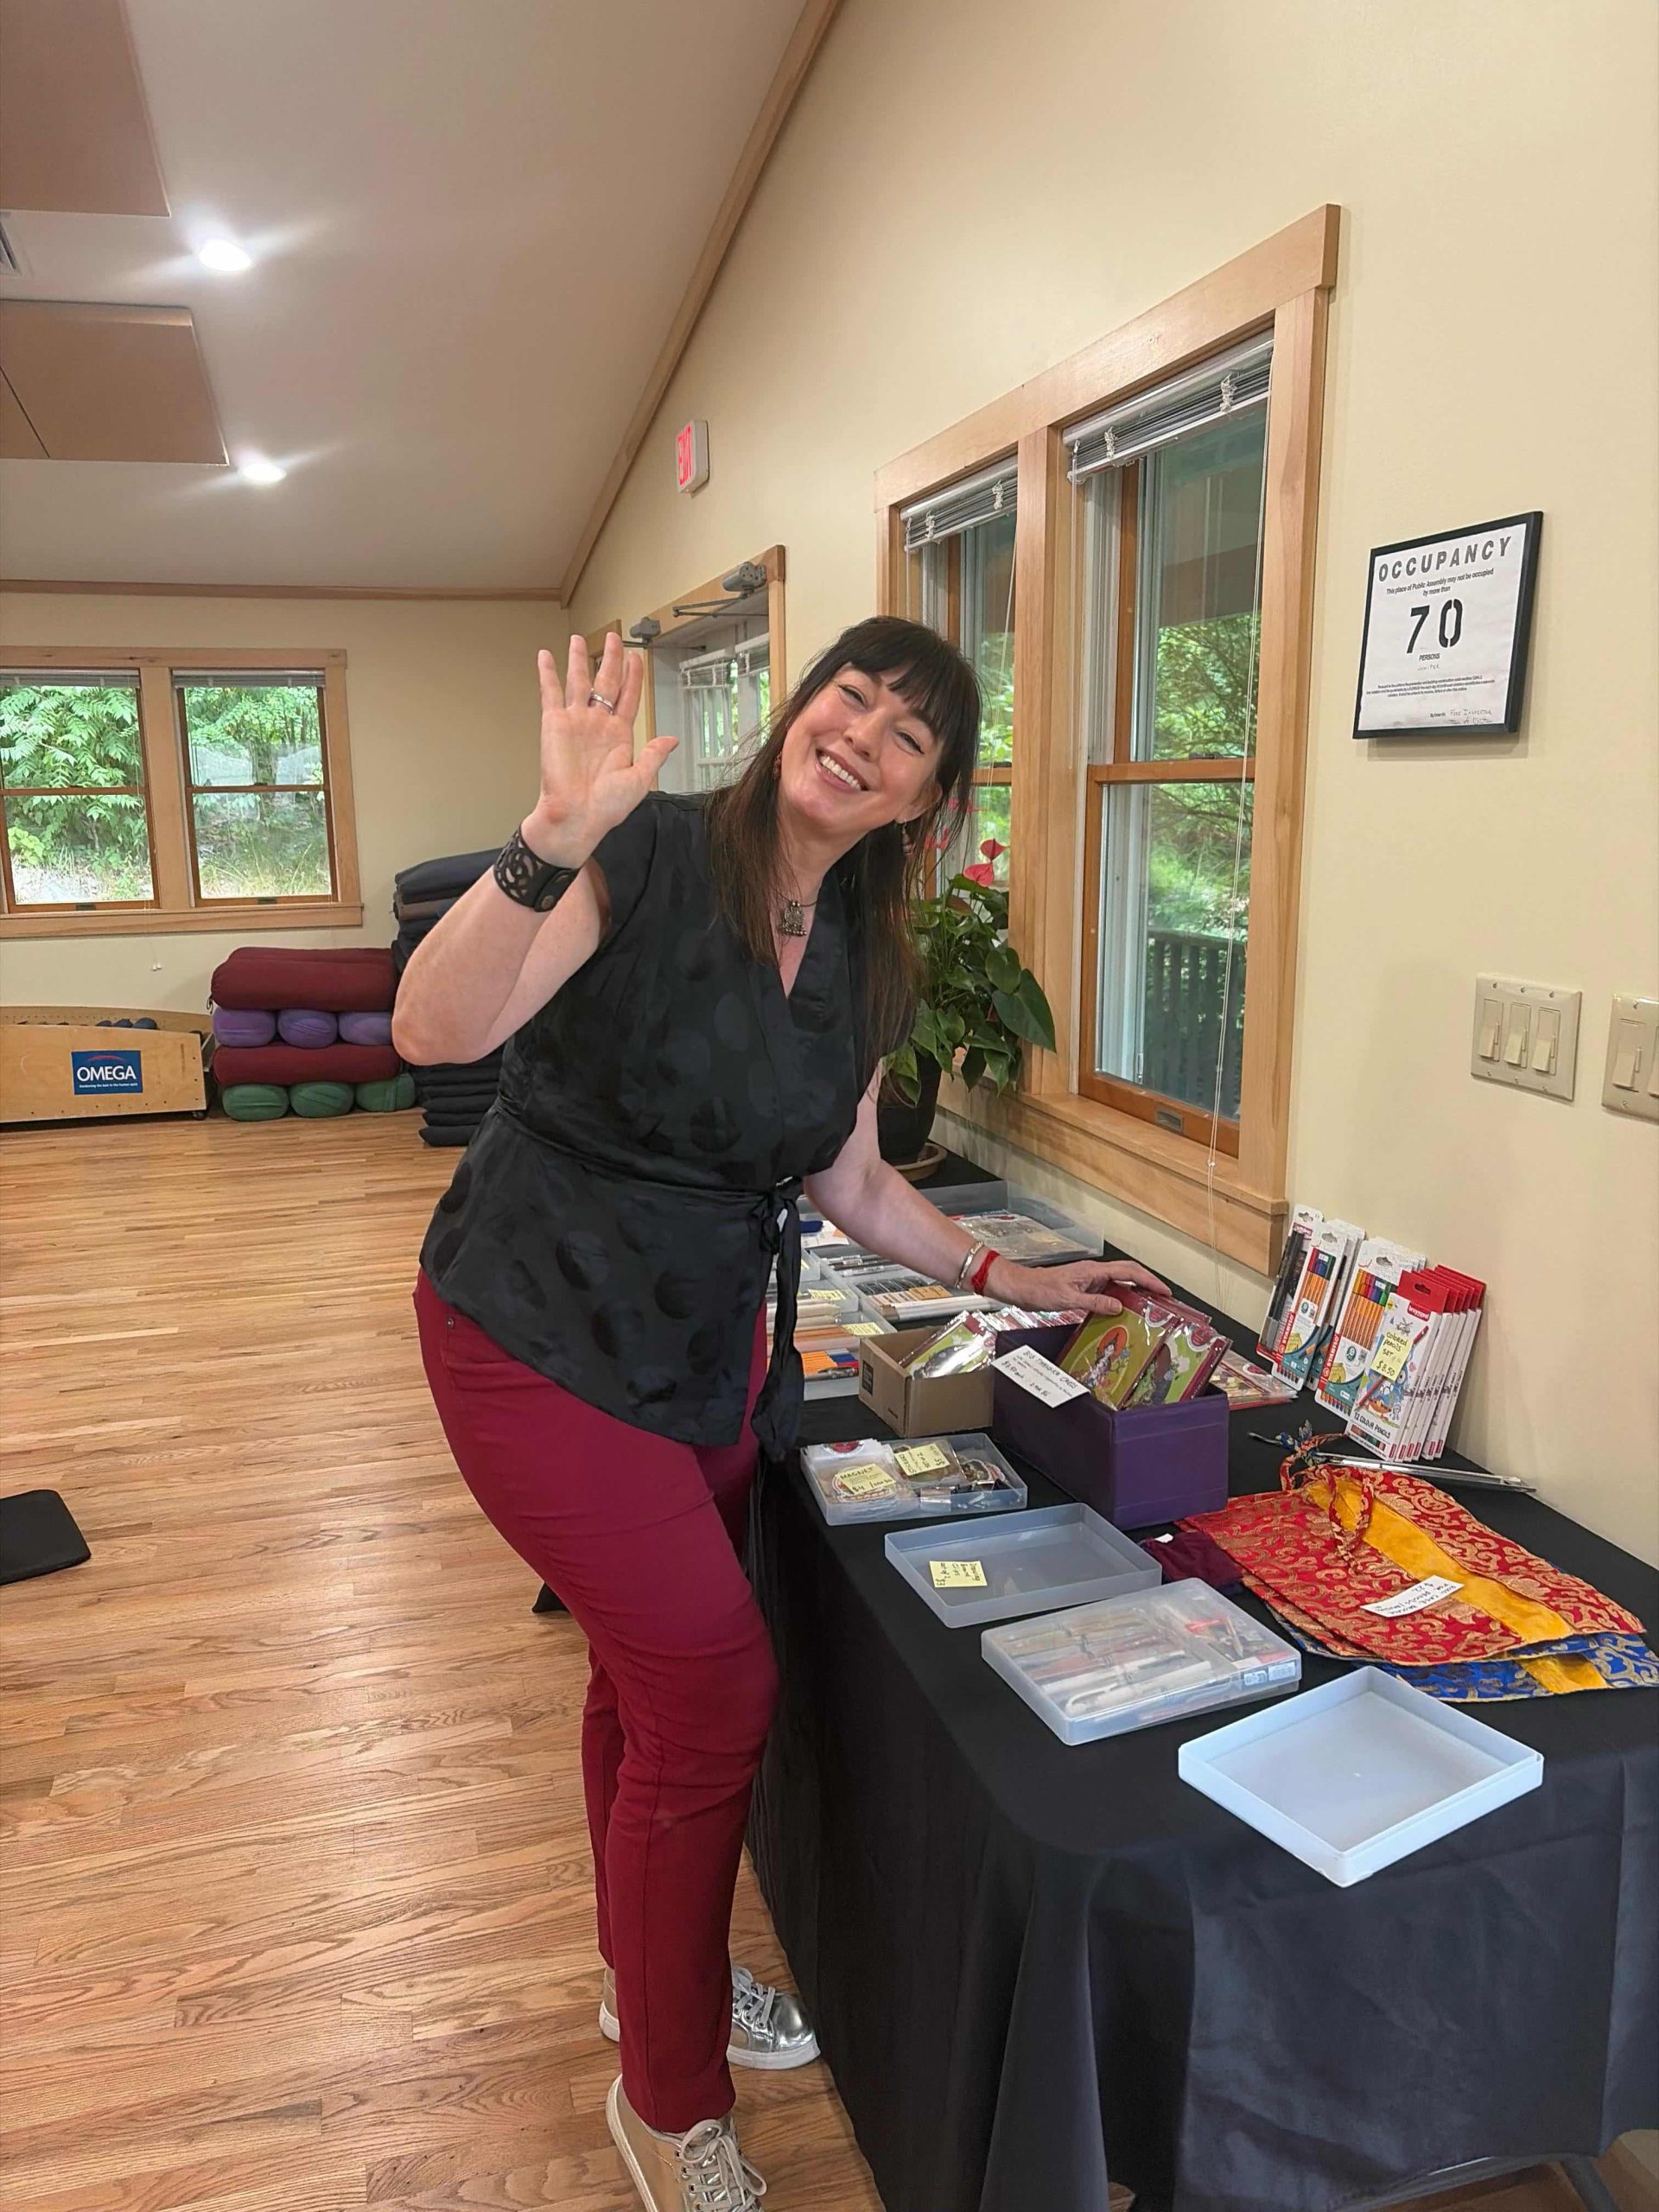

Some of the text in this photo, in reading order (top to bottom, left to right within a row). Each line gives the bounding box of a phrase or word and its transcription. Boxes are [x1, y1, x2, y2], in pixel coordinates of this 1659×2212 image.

[1378, 537, 1511, 582] OCCUPANCY
[1395, 585, 1407, 594] place
[1412, 581, 1425, 590] Public
[1427, 577, 1446, 588] Assembly
[1447, 575, 1456, 584] may
[1471, 568, 1493, 580] occupied
[1406, 598, 1463, 654] 70
[1419, 653, 1440, 662] PERSONS
[77, 1065, 137, 1082] OMEGA
[1282, 1315, 1294, 1344] STABILO
[1386, 1332, 1408, 1345] colored
[1325, 1336, 1338, 1367] STABILO
[1382, 1339, 1402, 1352] pencils
[1376, 1360, 1395, 1376] $8.50
[1360, 1415, 1375, 1430] COLOUR
[1375, 1425, 1391, 1440] PENCILS
